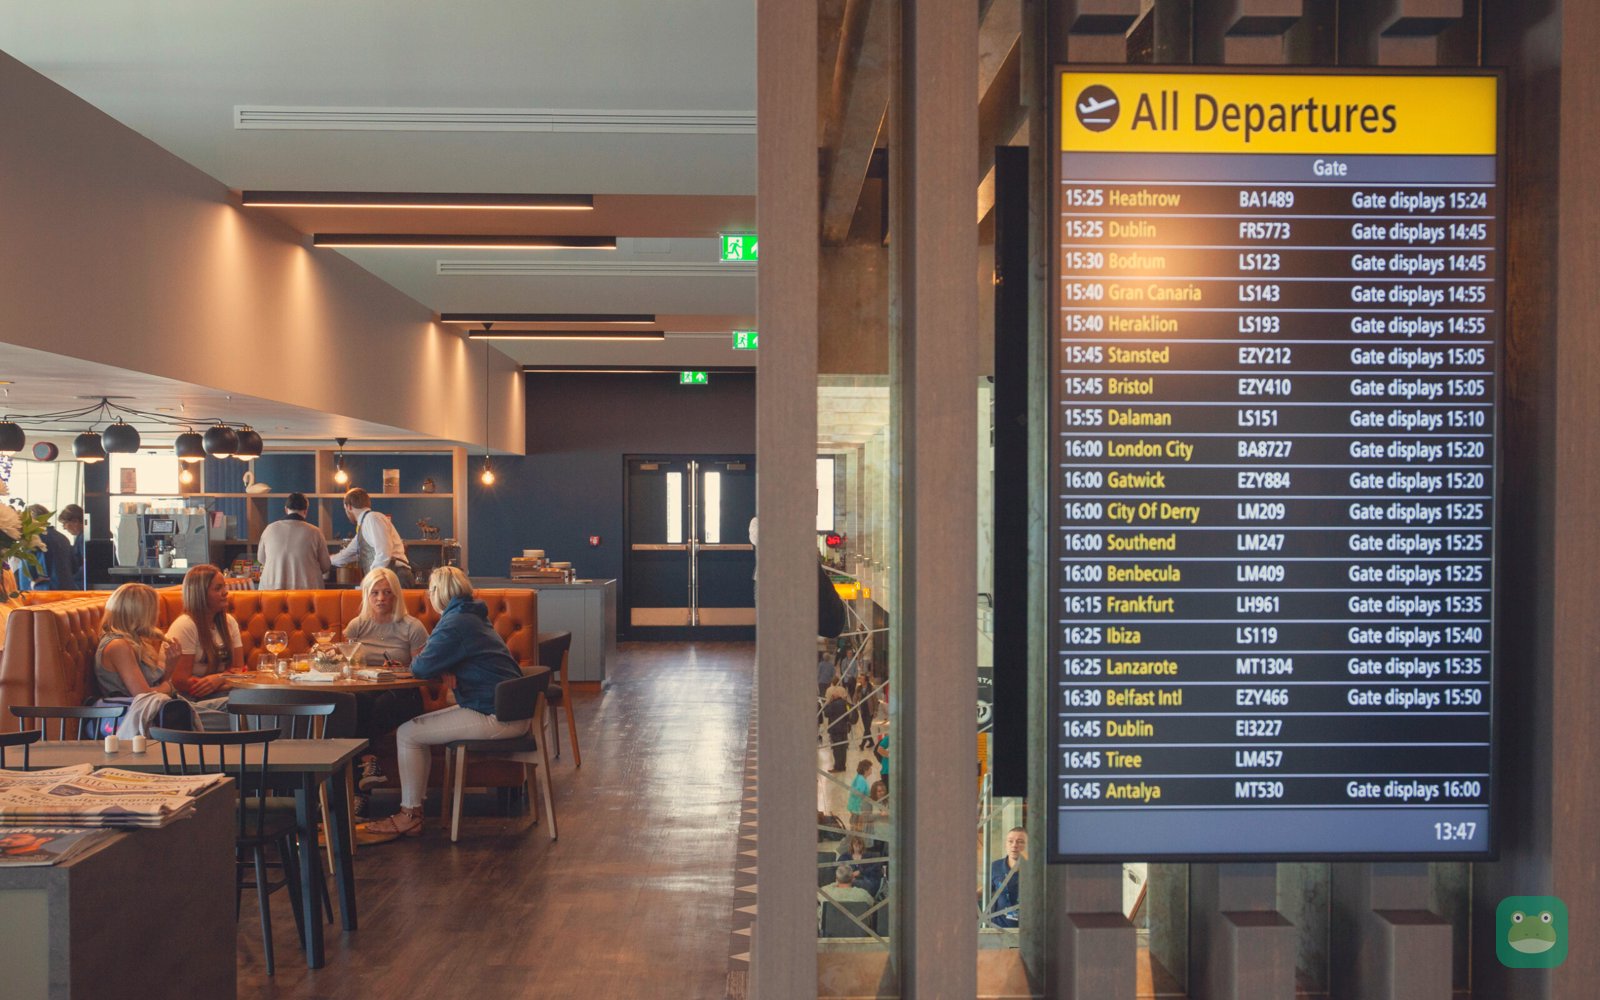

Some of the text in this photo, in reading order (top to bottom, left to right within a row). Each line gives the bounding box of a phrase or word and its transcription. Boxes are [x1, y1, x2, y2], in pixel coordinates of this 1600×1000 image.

[1131, 91, 1397, 143] All Departures
[1313, 159, 1347, 177] Gate
[1065, 188, 1487, 212] 15:25 Heathrow BA1489 Gate displays 15:24
[1065, 220, 1487, 244] 15:25 Dublin FR5773 Gate displays 14:45
[1064, 251, 1486, 275] 15:30 Bodrum LS123 Gate displays 14:45
[1064, 282, 1486, 306] 15:40 Gran Canaria LS143 Gate displays 14:55
[1065, 314, 1486, 337] 15:40 Heraklion LS193 Gate displays 14:55
[1064, 345, 1485, 368] 15:45 Stansted EZY212 Gate displays 15:05
[1064, 377, 1485, 399] 15:45 Bristol EZY410 Gate displays 15:05
[1064, 408, 1485, 431] 15:55 Dalaman LS151 Gate displays 15:10
[1064, 439, 1485, 462] 16:00 London City BA8727 Gate displays 15:20
[1064, 470, 1484, 493] 16:00 Gatwick EZY884 Gate displays 15:20
[1064, 501, 1484, 524] 16:00 City Of Derry LM209 Gate displays 15:25
[1064, 533, 1483, 554] 16:00 Southend LM247 Gate displays 15:25
[1064, 564, 1483, 585] 16:00 Benbecula LM409 Gate displays 15:25
[1063, 594, 1483, 616] 16:15 Frankfurt LH961 Gate displays 15:35
[1063, 626, 1483, 647] 16:25 Ibiza LS119 Gate displays 15:40
[1063, 657, 1482, 678] 16:25 Lanzarote MT1304 Gate displays 15:35
[1063, 688, 1482, 709] 16:30 Belfast Intl EZY466 Gate displays 15:50
[1063, 719, 1283, 738] 16:45 Dublin EI3227
[1063, 750, 1283, 769] 16:45 Tiree LM457
[1062, 780, 1481, 803] 16:45 Antalya MT530 Gate displays 16:00
[1435, 822, 1477, 841] 13:47
